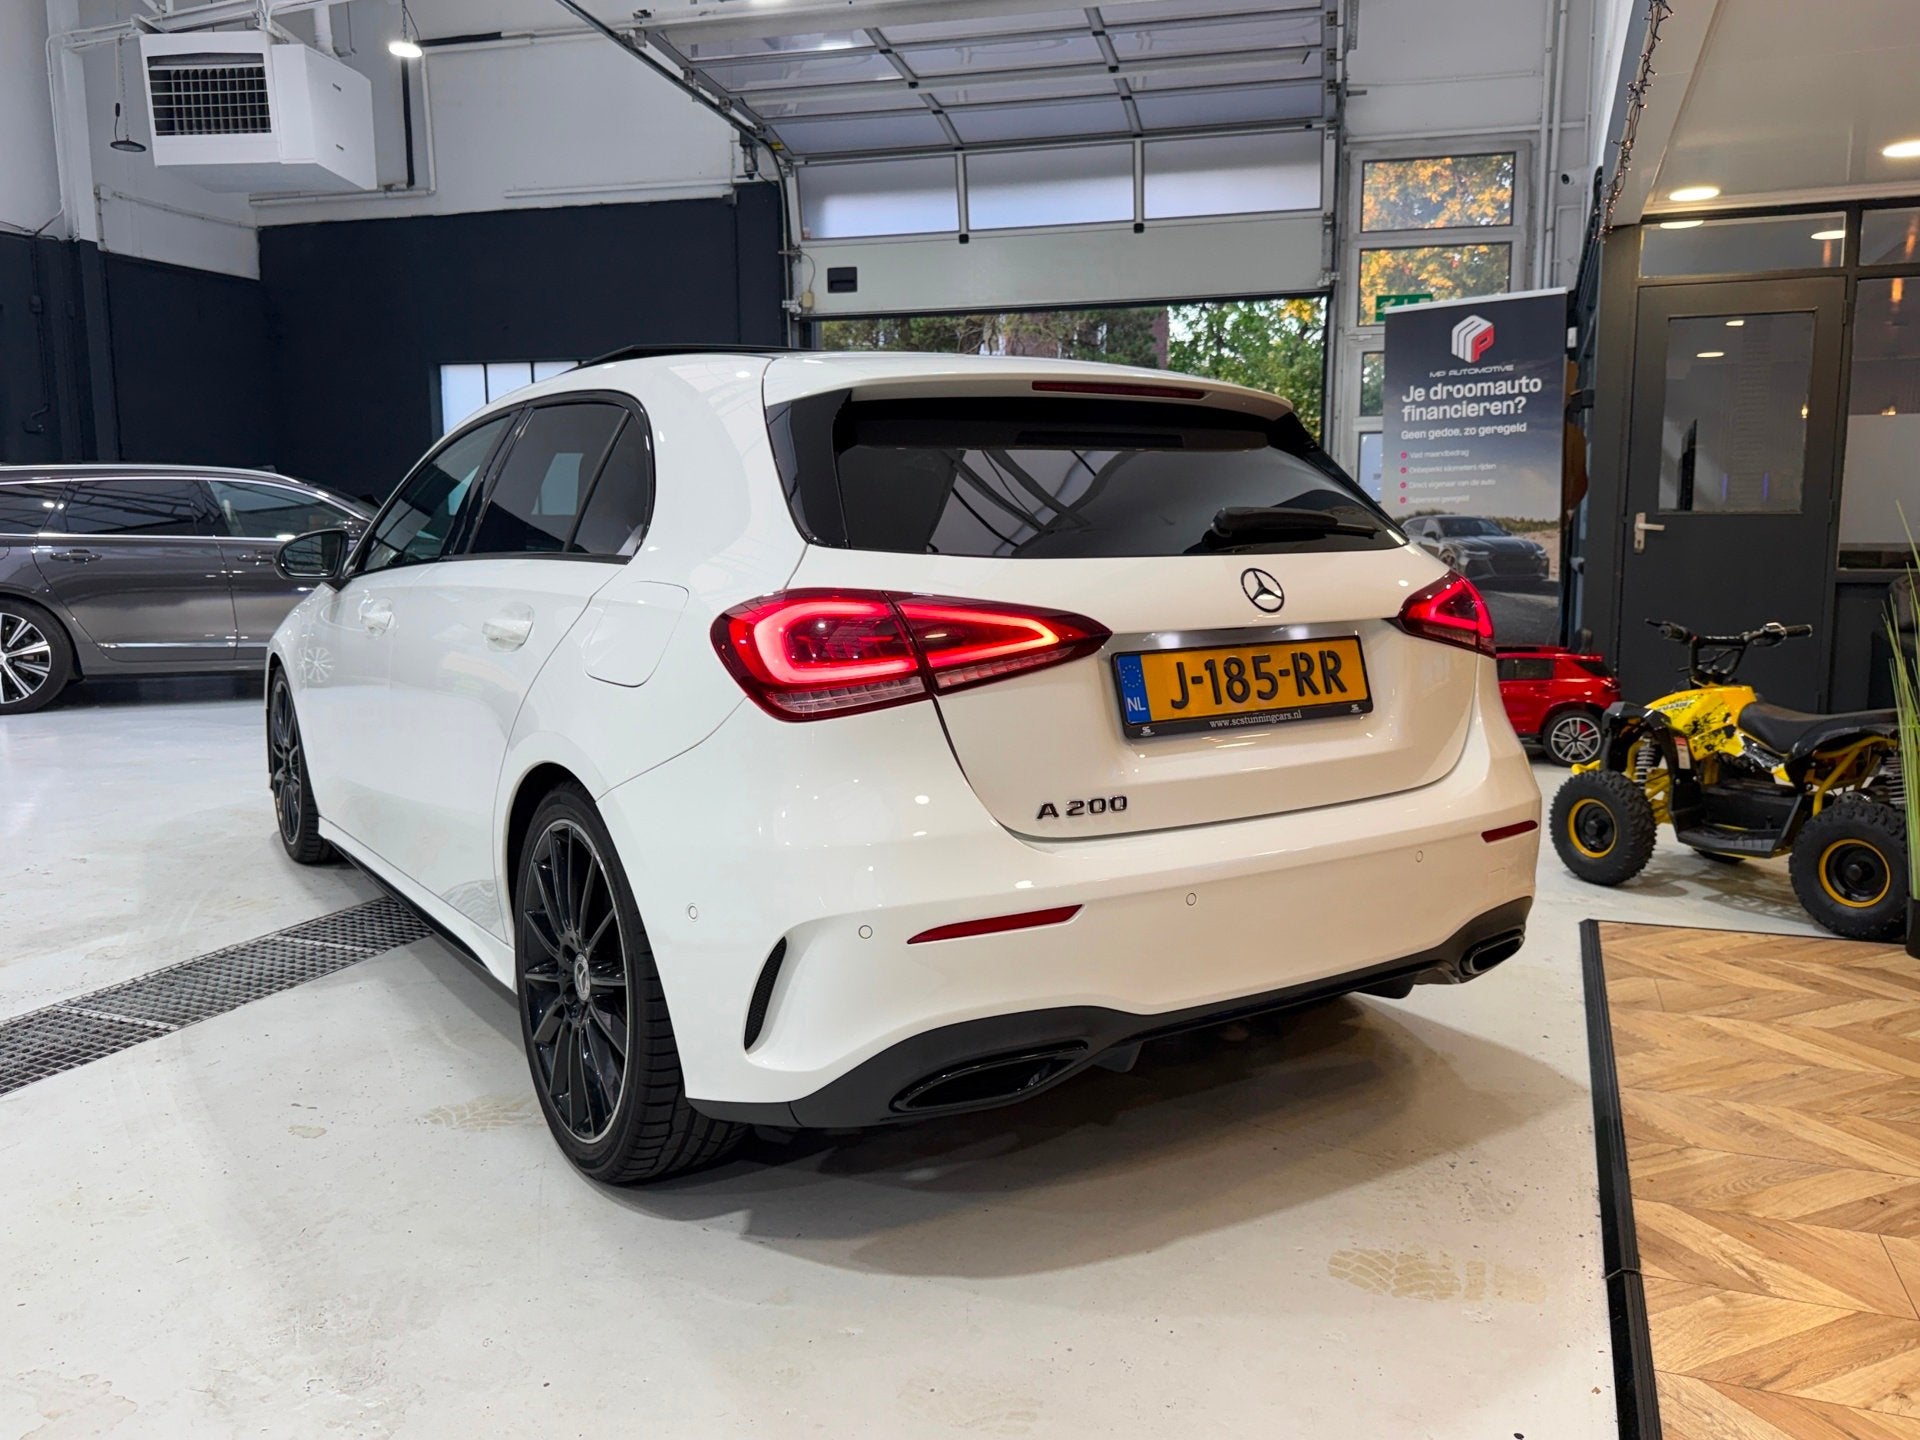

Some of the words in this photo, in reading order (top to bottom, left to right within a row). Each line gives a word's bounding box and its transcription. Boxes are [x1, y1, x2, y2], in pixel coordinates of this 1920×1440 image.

[1448, 364, 1514, 376] AUTOMOTIVE
[1402, 385, 1425, 403] Je
[1429, 375, 1542, 400] droomauto
[1401, 396, 1527, 422] financieren?
[1401, 430, 1426, 440] Geen
[1463, 427, 1477, 436] zo
[1478, 422, 1527, 437] geregeld
[1170, 650, 1348, 710] J-185-RR
[1126, 697, 1146, 712] NL
[1209, 711, 1302, 728] www.scstunningcars.nl
[1036, 803, 1059, 820] A
[1066, 795, 1128, 817] 200
